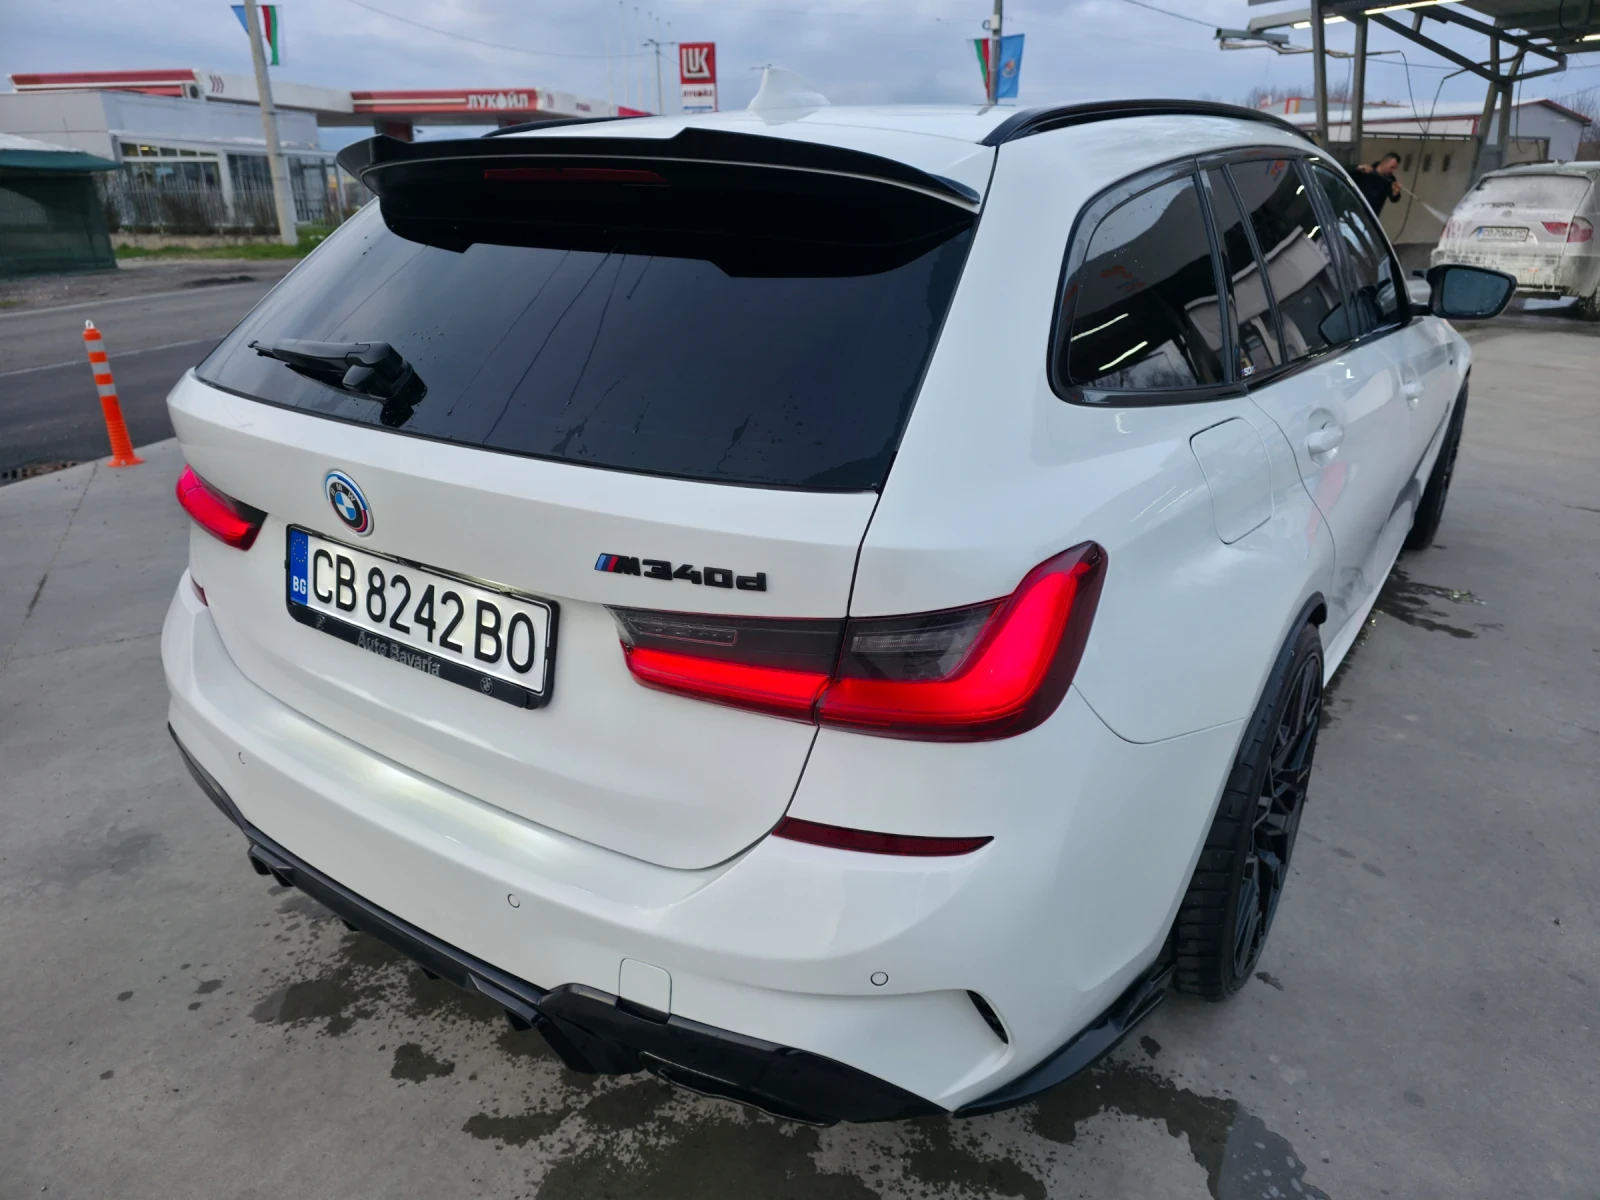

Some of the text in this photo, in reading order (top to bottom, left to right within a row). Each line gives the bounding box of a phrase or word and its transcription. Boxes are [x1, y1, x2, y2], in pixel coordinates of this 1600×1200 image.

[467, 91, 529, 110] ЛУКОЙЛ
[330, 483, 357, 502] BMW
[293, 575, 307, 595] BG
[594, 552, 767, 592] M340d
[312, 548, 535, 675] CB 8242 BO
[357, 630, 441, 677] Auto Bavaria
